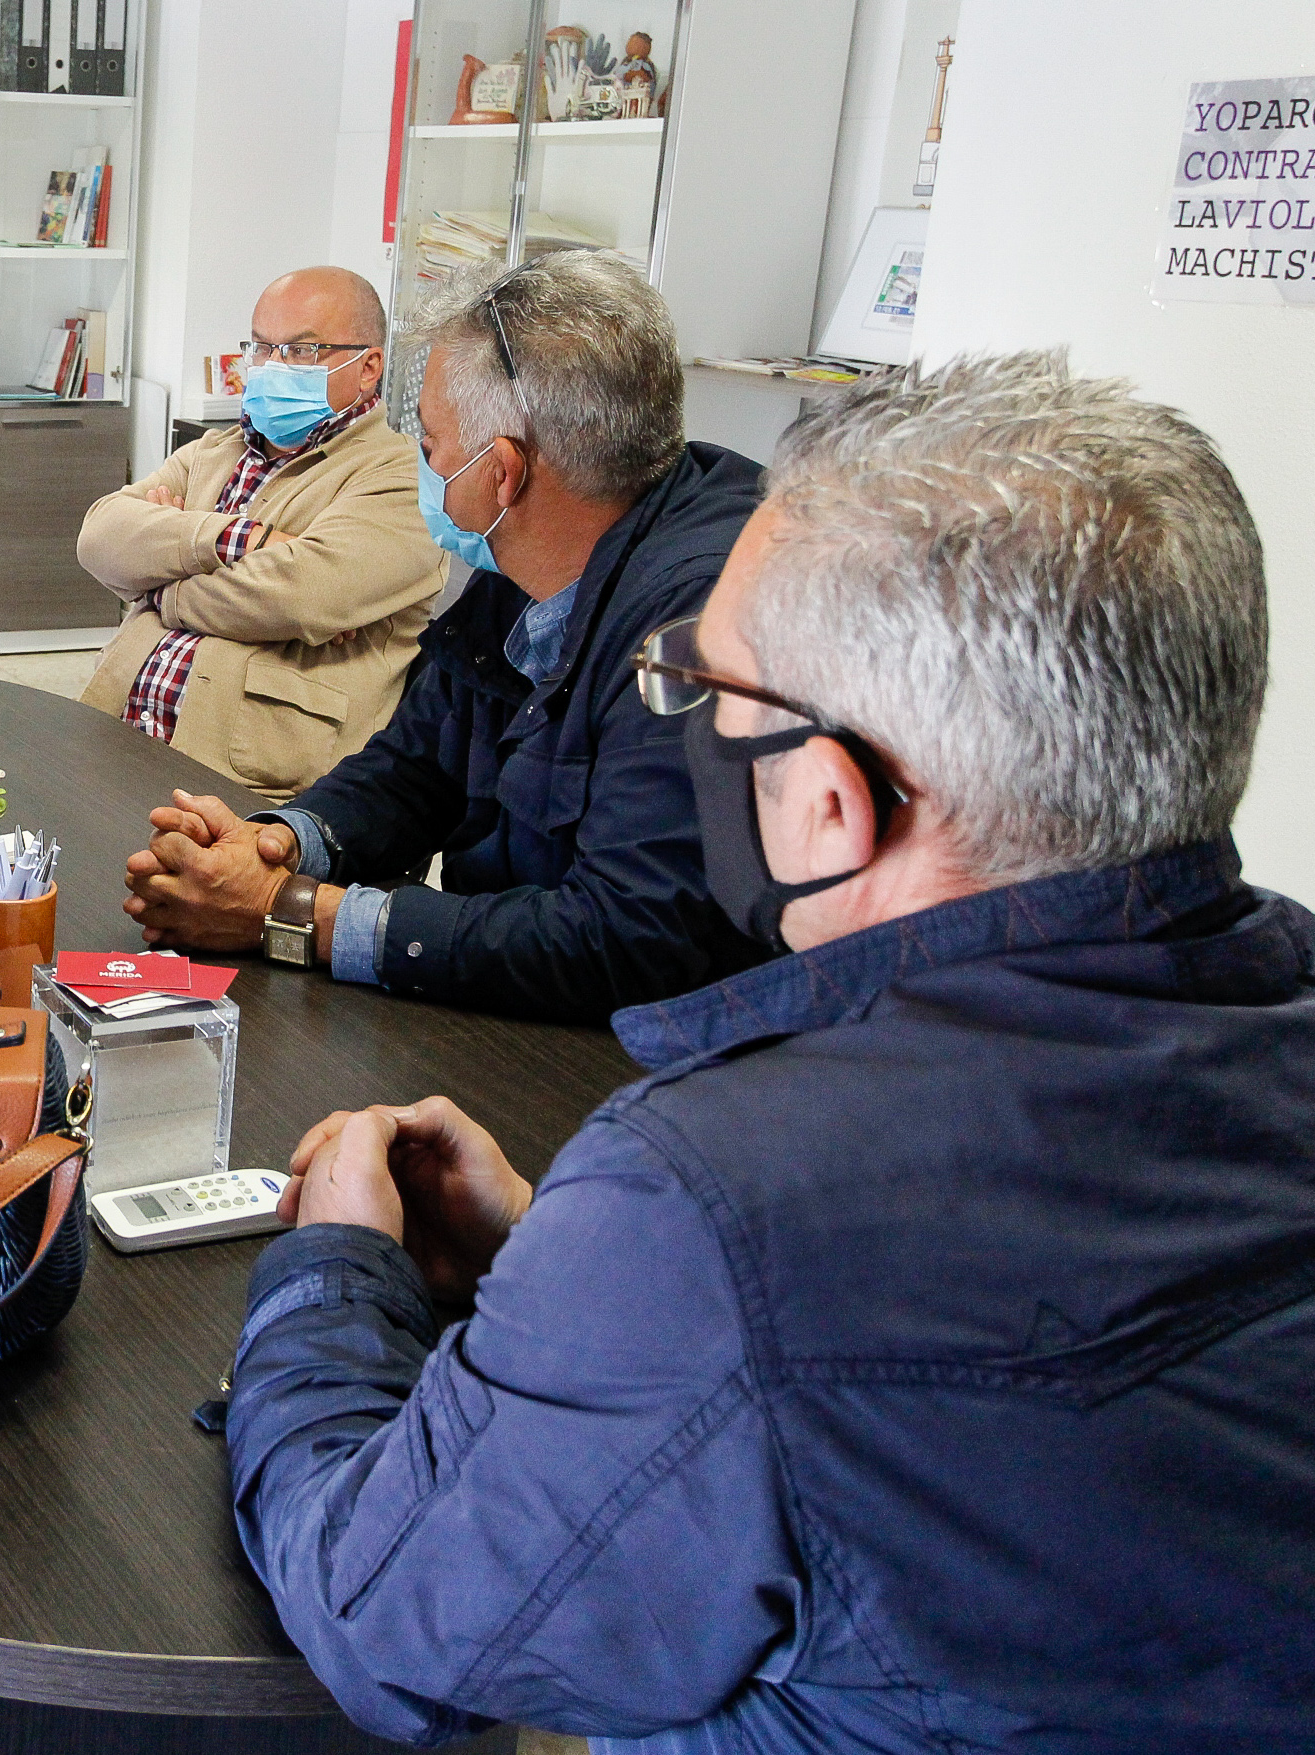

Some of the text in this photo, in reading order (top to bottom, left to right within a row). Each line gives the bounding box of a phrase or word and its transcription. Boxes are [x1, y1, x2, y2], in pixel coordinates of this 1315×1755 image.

[1194, 98, 1315, 132] YOPAR
[1173, 199, 1315, 230] LAVIOL
[1164, 247, 1315, 281] MACHIS
